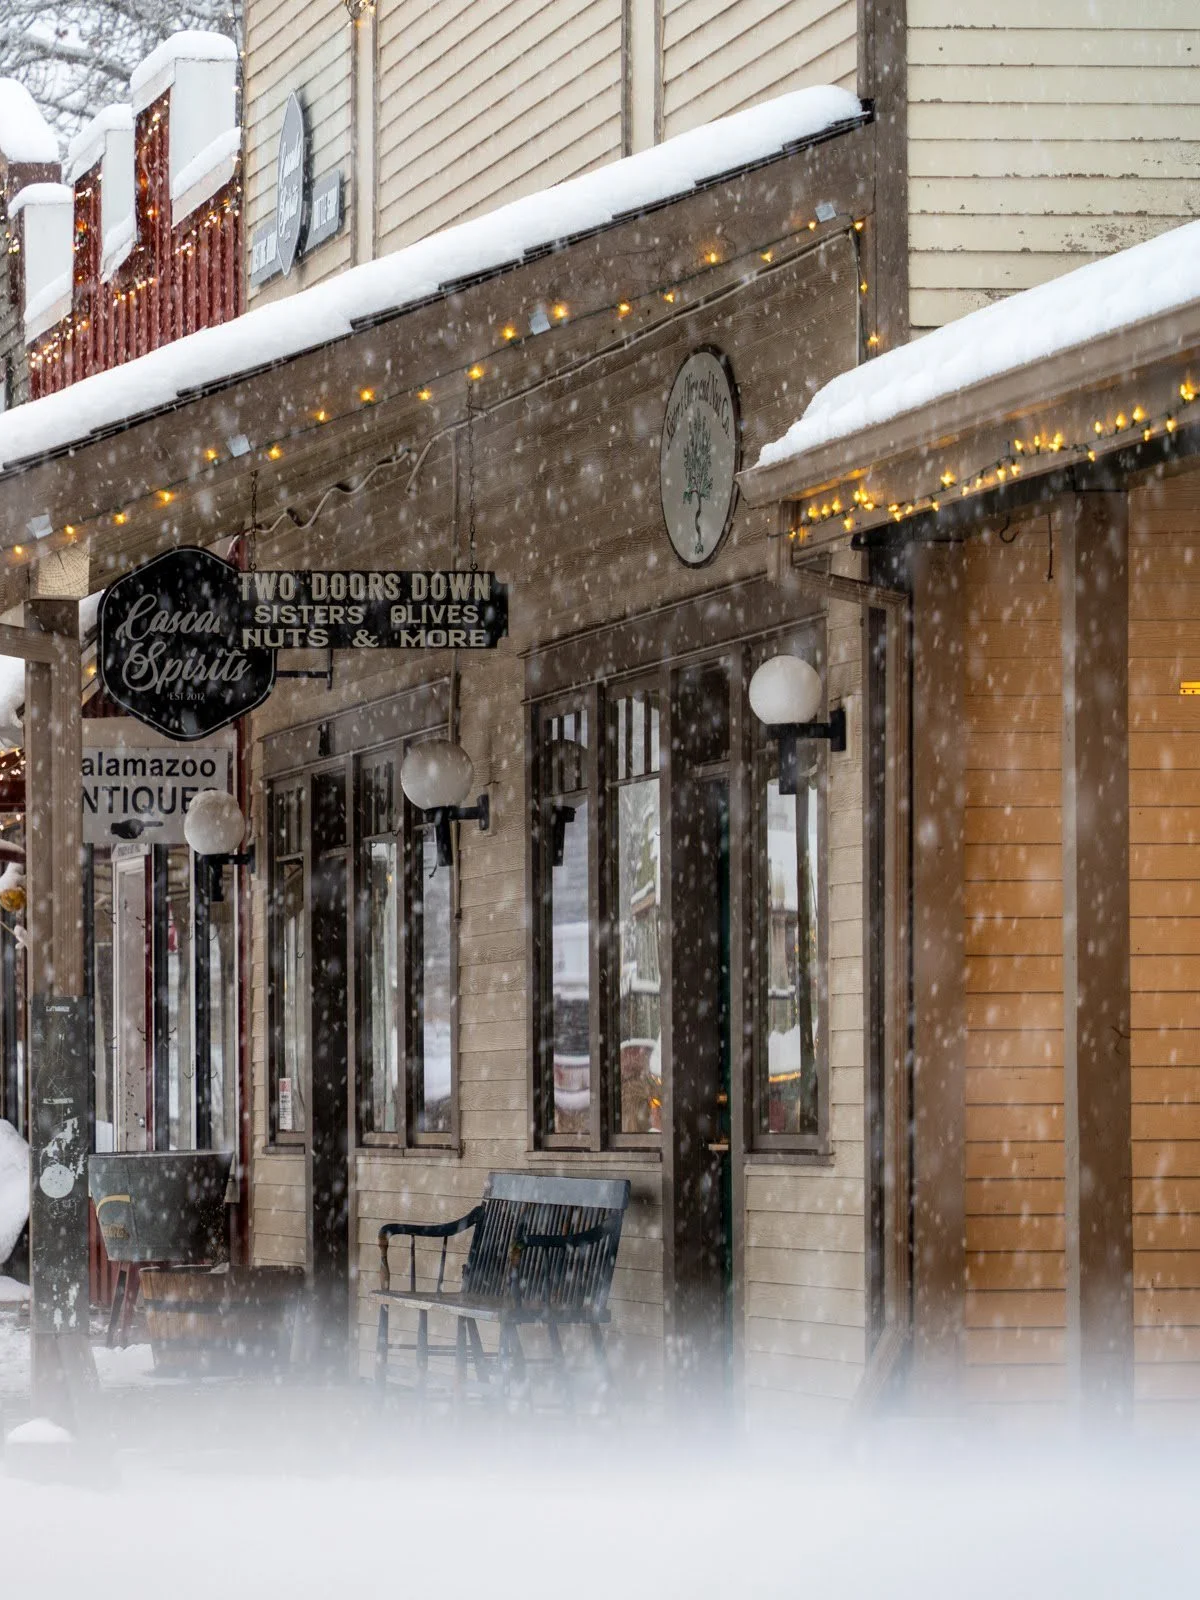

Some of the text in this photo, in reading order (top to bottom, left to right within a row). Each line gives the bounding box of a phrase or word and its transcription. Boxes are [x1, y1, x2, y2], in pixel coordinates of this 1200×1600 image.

[238, 572, 492, 601] TWO DOORS DOWN
[115, 593, 221, 641] Casca
[390, 604, 480, 625] OLIVES
[242, 628, 487, 649] NUTS & MORE
[121, 641, 253, 695] Spirits
[82, 751, 217, 777] alamazoo
[82, 786, 220, 816] NTIQUE
